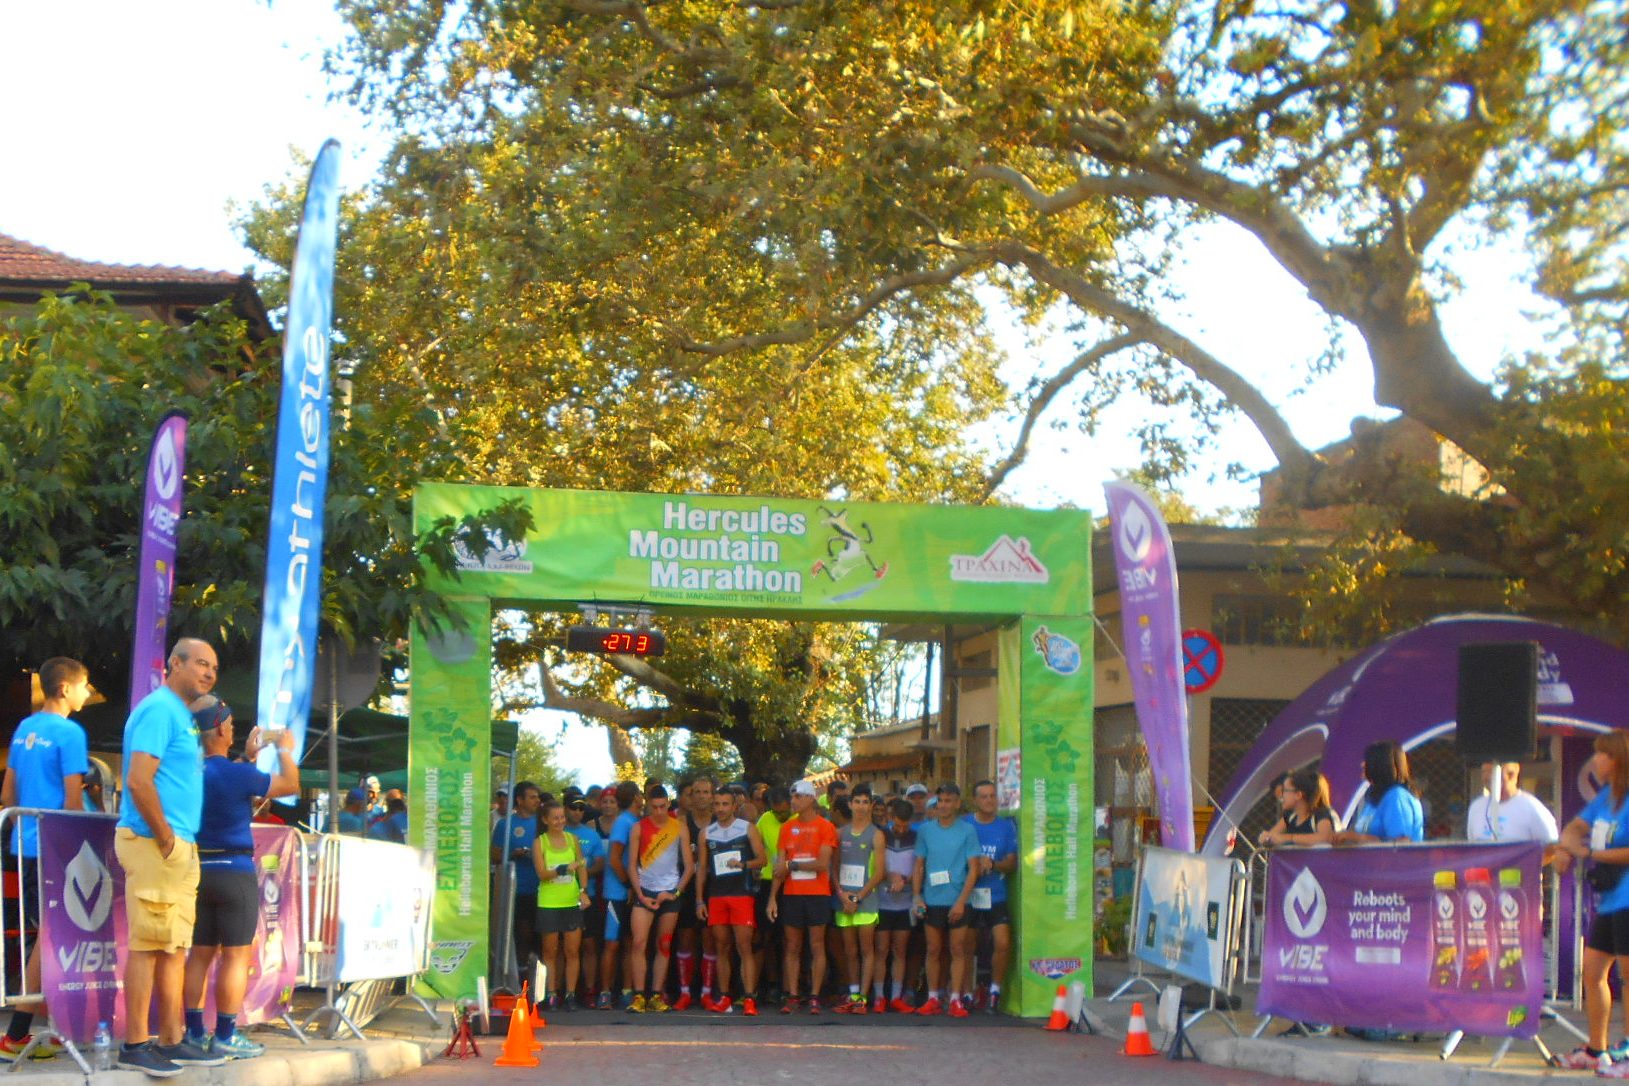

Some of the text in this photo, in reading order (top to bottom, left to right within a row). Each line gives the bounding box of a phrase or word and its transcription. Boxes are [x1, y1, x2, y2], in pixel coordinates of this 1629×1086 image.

[663, 501, 807, 535] Hercules
[629, 530, 780, 562] Mountain
[650, 560, 802, 593] Marathon
[1065, 783, 1078, 833] Marathon
[437, 769, 459, 891] ΕΛΛΕΒΟΡΟΣ
[459, 772, 473, 916] Helleborus Half Marathon
[1045, 780, 1065, 896] ΕΛΛΕΒΟΡΟΣ
[1353, 891, 1406, 907] Reboots
[1348, 906, 1411, 926] your mind
[1350, 924, 1408, 943] and body
[59, 940, 117, 973] VIBE
[1279, 944, 1329, 970] VIBE
